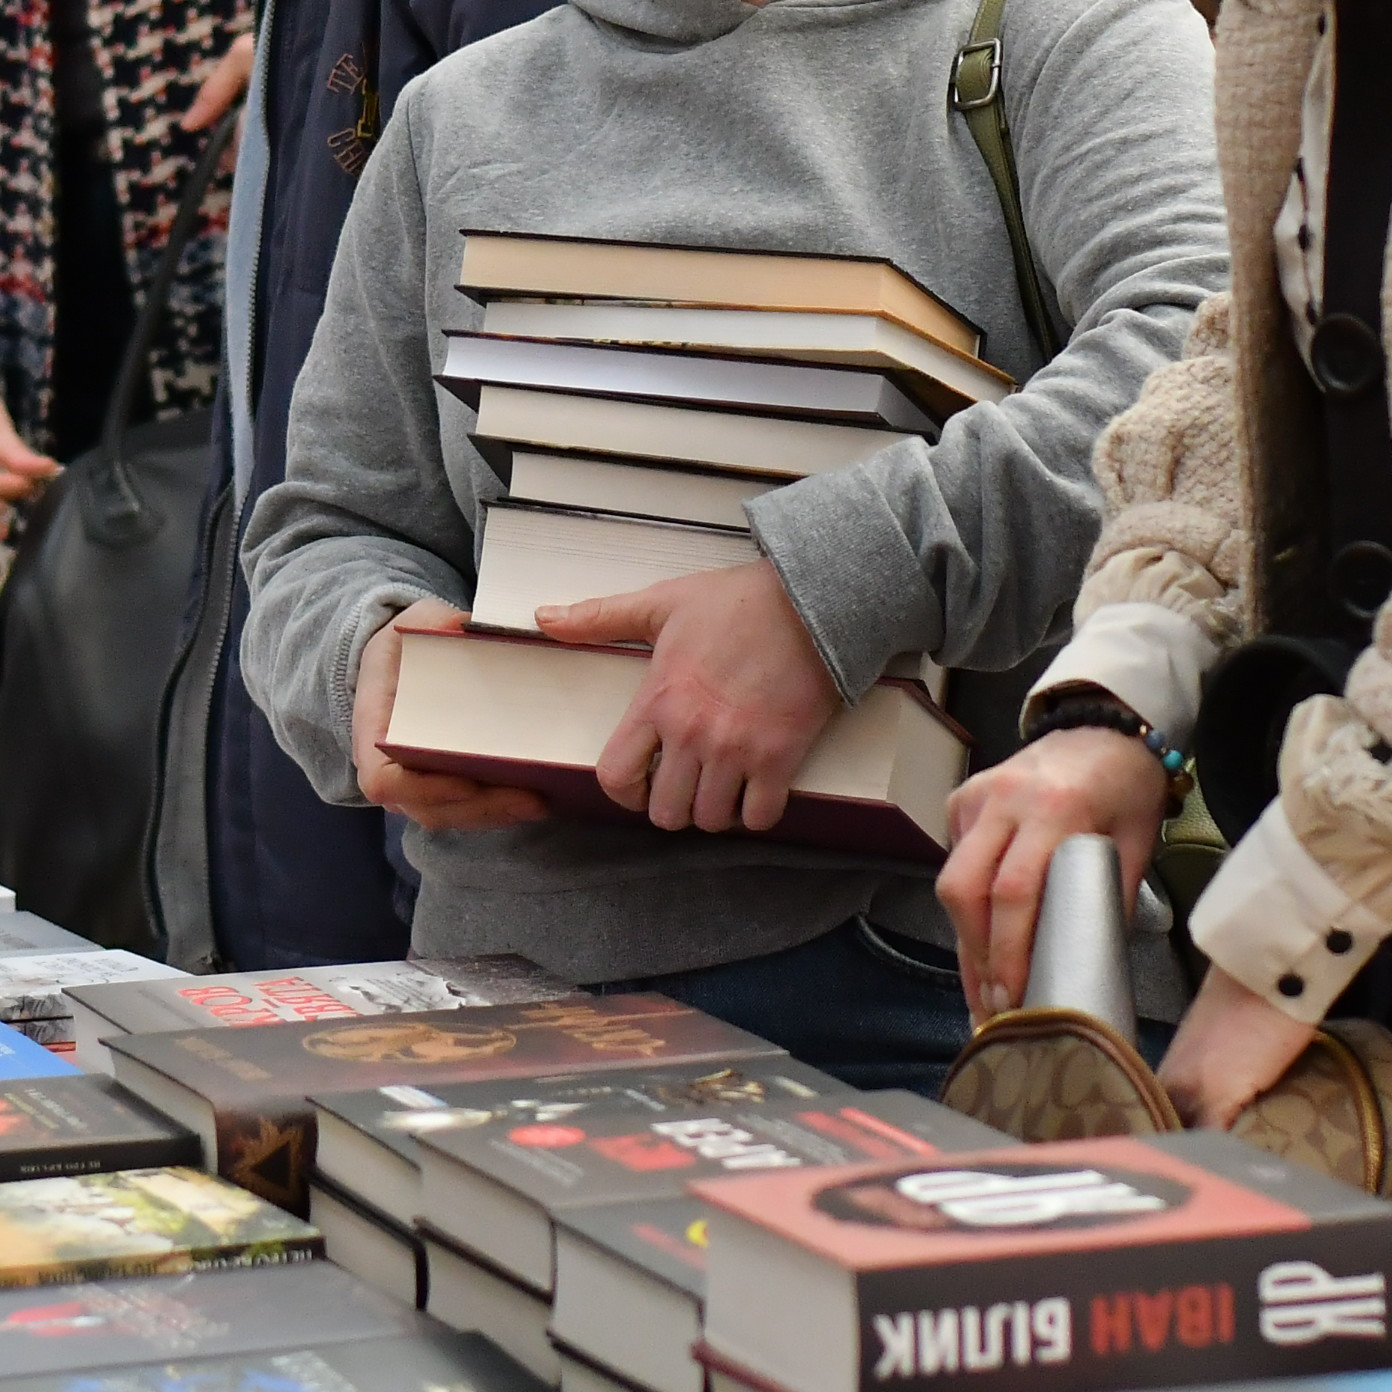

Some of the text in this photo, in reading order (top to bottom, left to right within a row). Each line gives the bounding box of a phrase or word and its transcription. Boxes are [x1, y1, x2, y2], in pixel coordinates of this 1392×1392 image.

[872, 1258, 1387, 1378] ЯР ІВАН БІЛИК
